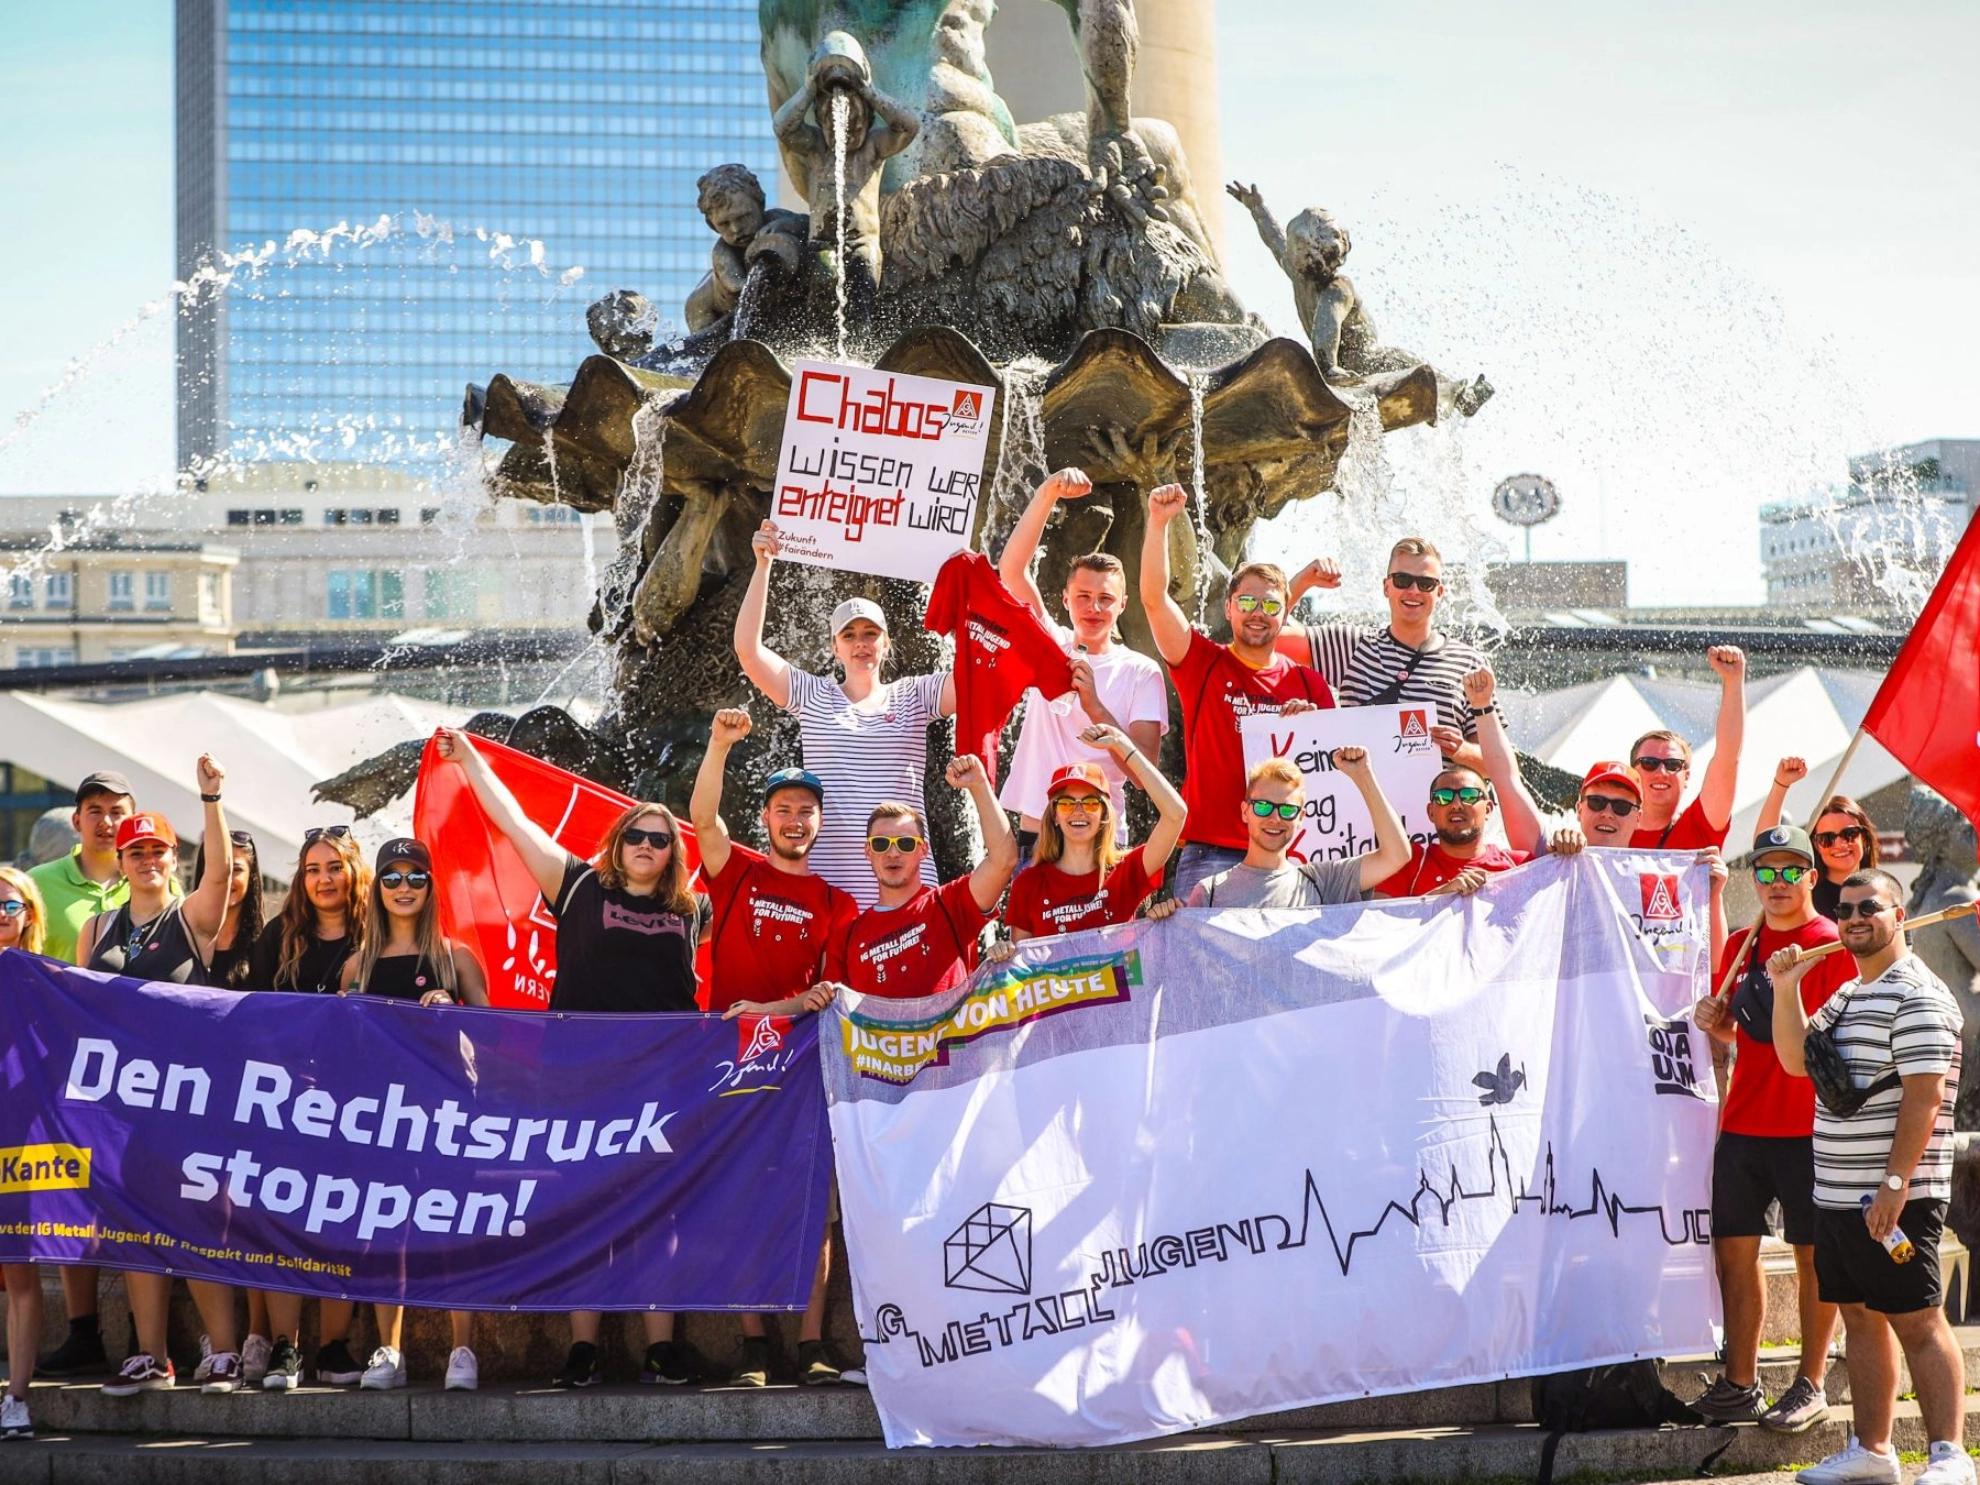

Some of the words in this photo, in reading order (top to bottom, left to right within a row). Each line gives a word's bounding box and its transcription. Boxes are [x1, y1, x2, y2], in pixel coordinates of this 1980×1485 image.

[797, 370, 948, 440] Chabos
[778, 530, 817, 545] Zukunft
[778, 542, 834, 560] #fairändern
[1257, 703, 1282, 714] JUGEN
[1304, 794, 1336, 834] ag
[753, 908, 771, 918] FOR
[754, 900, 784, 914] METALL
[783, 904, 814, 920] JUGEND
[1042, 910, 1052, 920] IG
[1052, 904, 1083, 917] METALL
[1055, 914, 1072, 924] FOR
[869, 939, 899, 958] METALL
[899, 922, 927, 946] JUGEND
[872, 951, 889, 965] FOR
[953, 994, 1009, 1030] VON
[1016, 972, 1106, 1013] HEUTE
[1652, 1054, 1696, 1089] ULM
[65, 1037, 211, 1116] Den
[233, 1059, 678, 1164] Rechtsruck
[0, 1154, 80, 1184] Kante
[180, 1149, 538, 1241] stoppen!
[15, 1221, 35, 1235] der
[37, 1221, 51, 1236] IG
[53, 1222, 94, 1238] Metall
[98, 1226, 151, 1244] Jugend
[154, 1233, 177, 1248] für
[180, 1240, 242, 1262] Respekt
[245, 1252, 274, 1265] und
[277, 1255, 352, 1277] Solidarität
[917, 1288, 1115, 1368] METALL
[1091, 1214, 1298, 1289] JUGEND
